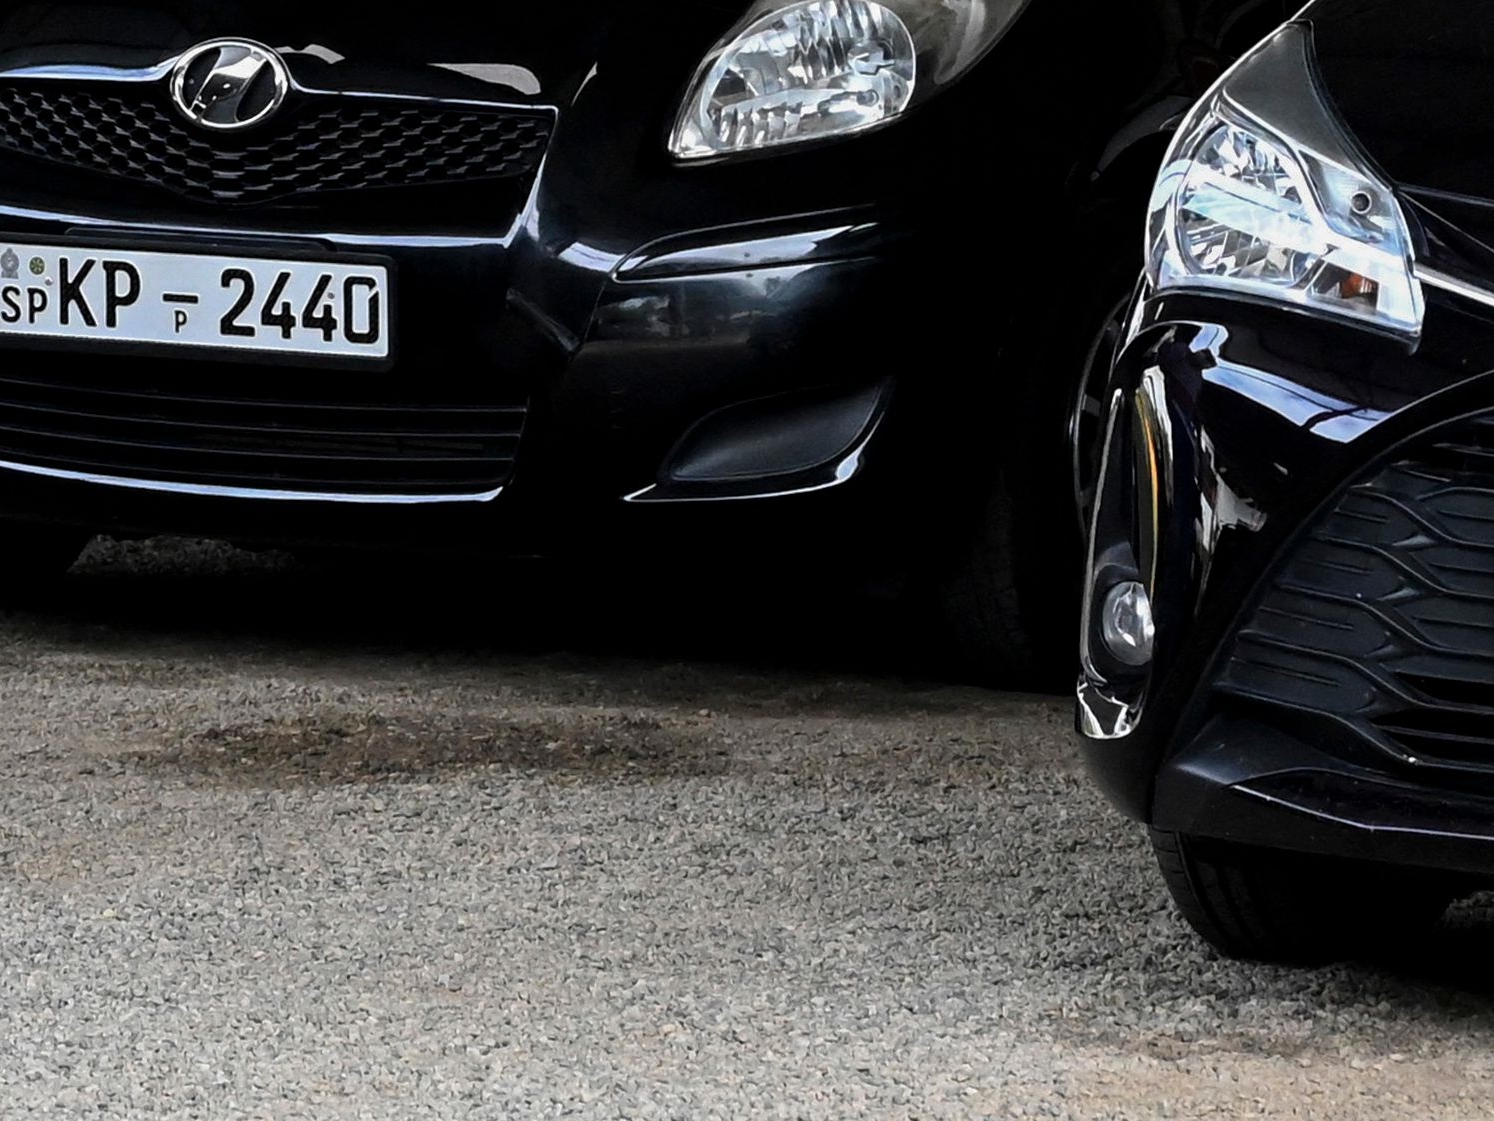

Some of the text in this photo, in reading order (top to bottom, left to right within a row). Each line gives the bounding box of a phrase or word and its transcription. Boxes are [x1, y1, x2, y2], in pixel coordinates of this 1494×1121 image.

[0, 286, 48, 324] SP
[58, 257, 141, 328] KP
[219, 268, 380, 345] 2440
